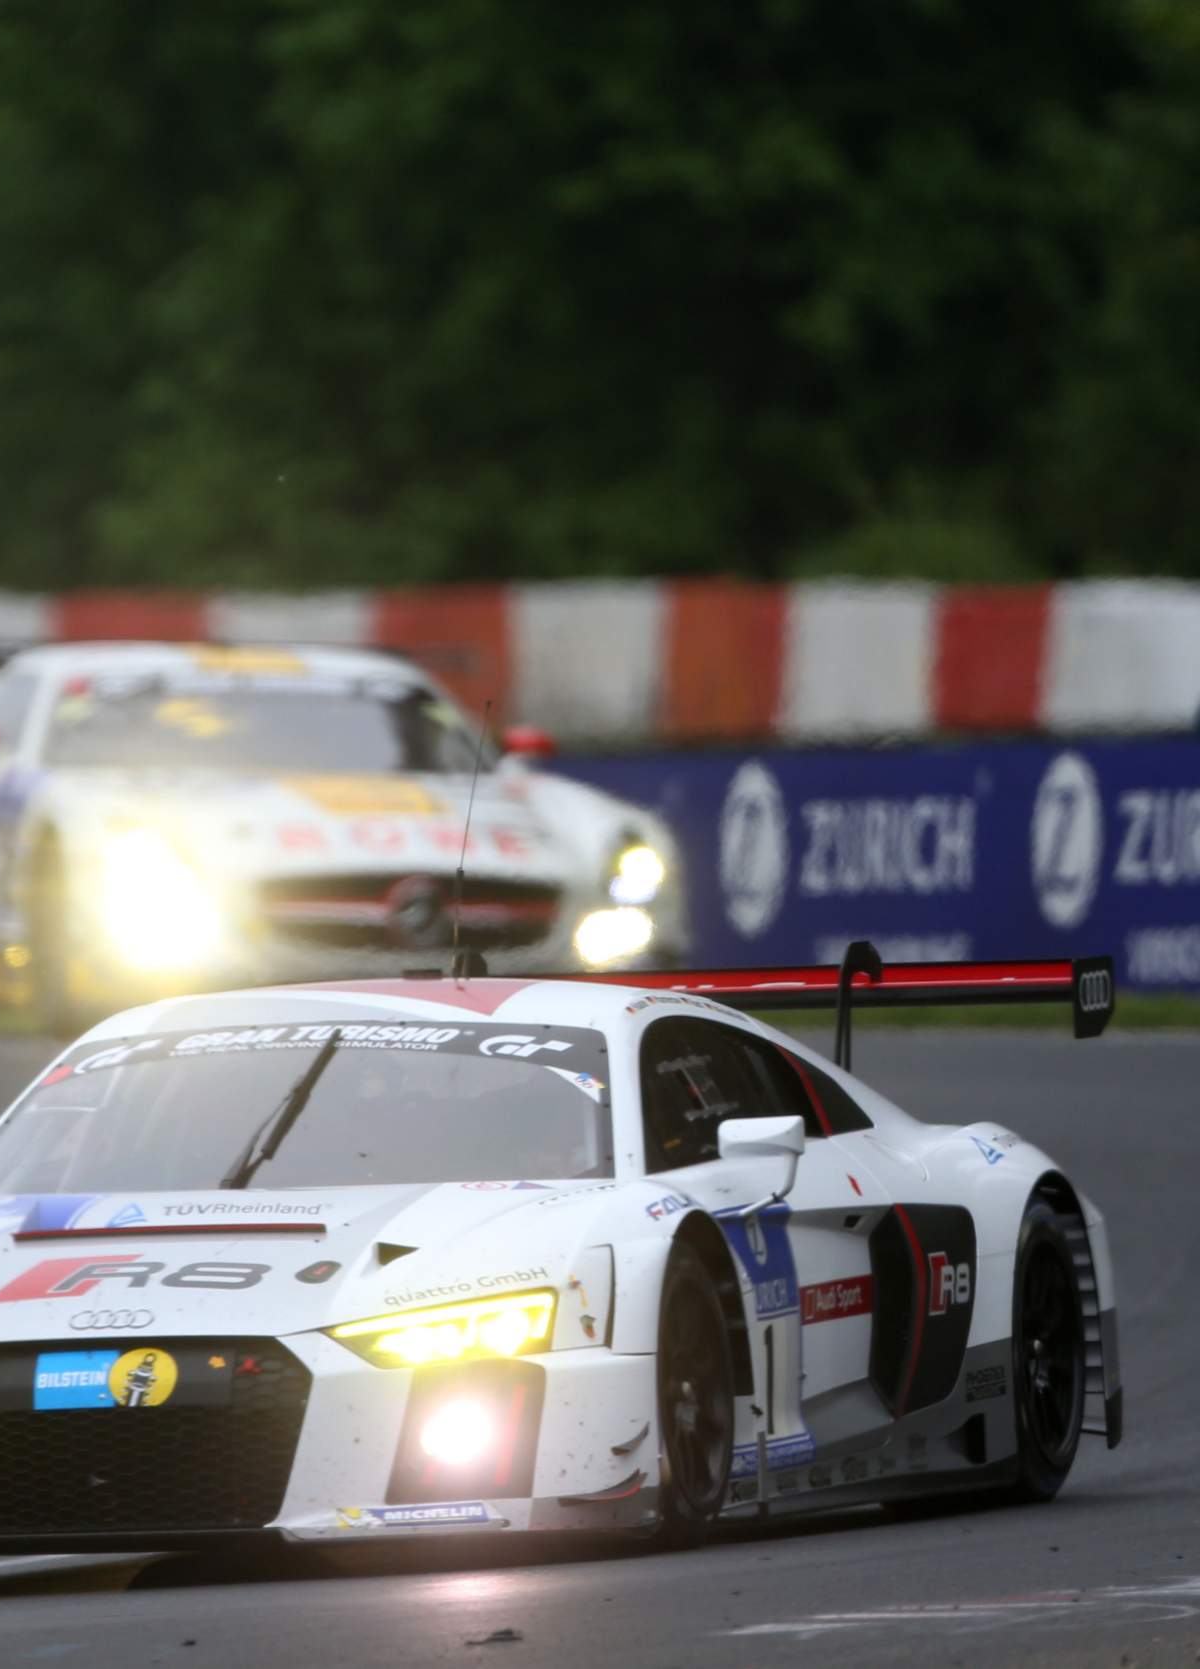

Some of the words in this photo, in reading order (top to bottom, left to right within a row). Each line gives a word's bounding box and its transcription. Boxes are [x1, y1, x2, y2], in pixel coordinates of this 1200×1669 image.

[801, 797, 977, 896] ZURICH
[175, 1028, 287, 1051] GRAN
[289, 1025, 460, 1044] TURISMO
[46, 1260, 273, 1292] R8
[383, 1281, 472, 1307] quattro
[477, 1267, 549, 1288] GmbH
[37, 1371, 107, 1390] BILSTEIN
[384, 1505, 483, 1521] MICHELIN
